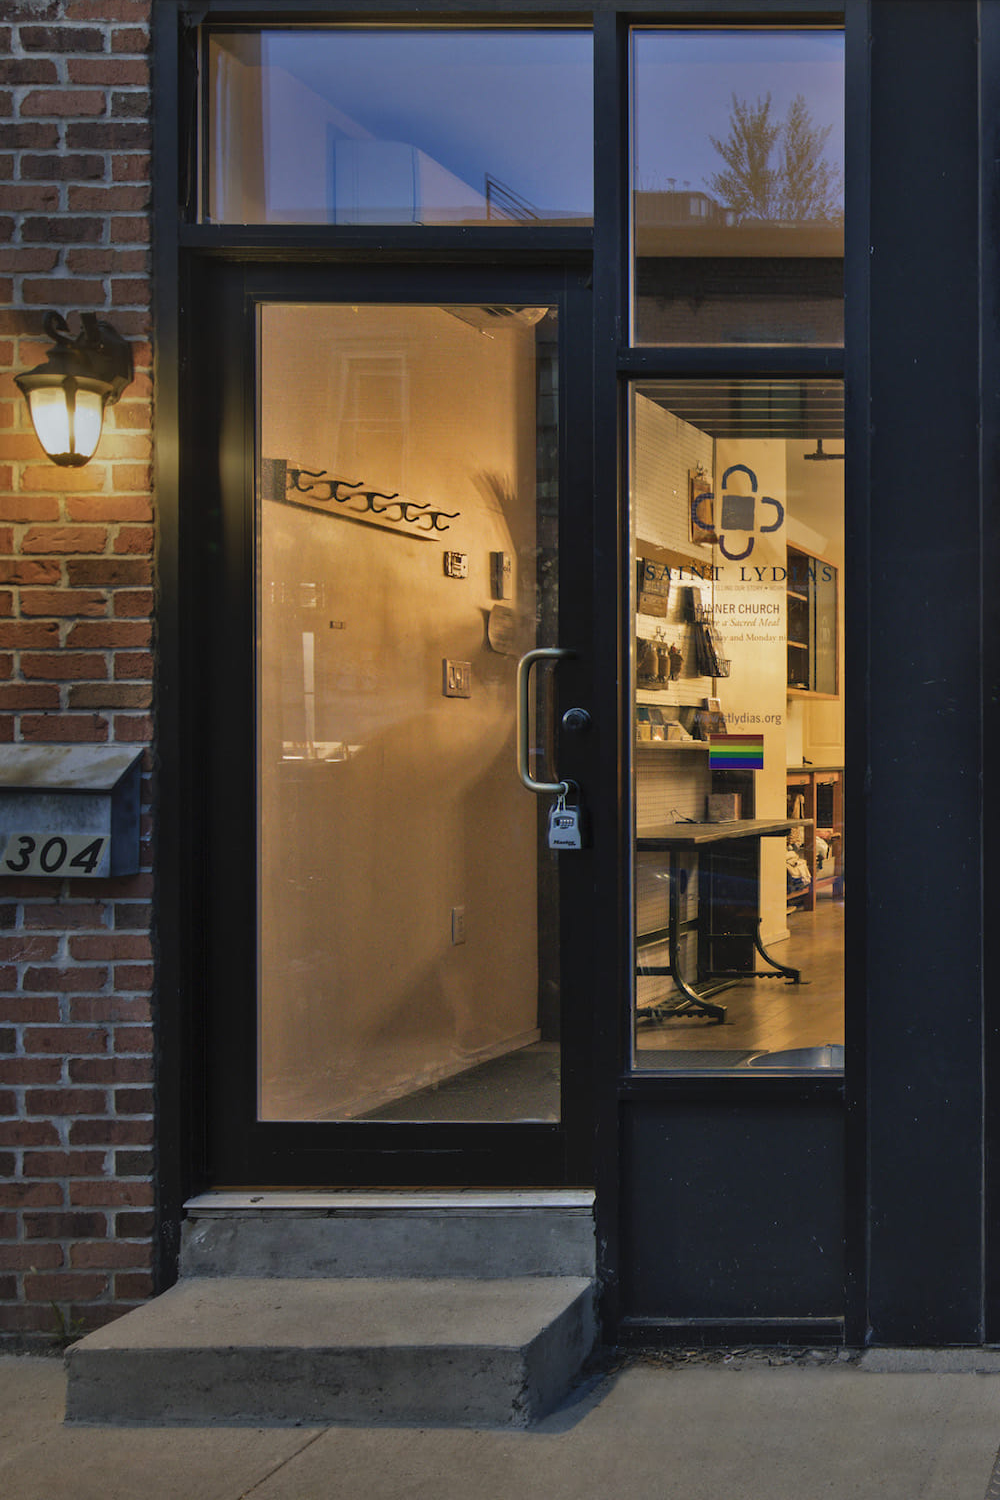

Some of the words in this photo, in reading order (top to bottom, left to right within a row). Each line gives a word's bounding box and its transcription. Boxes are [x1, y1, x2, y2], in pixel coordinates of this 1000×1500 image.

[645, 565, 725, 581] SAINT
[739, 566, 832, 582] LYDIAS
[696, 603, 735, 614] DINNER
[738, 603, 780, 614] CHURCH
[730, 617, 757, 627] Sacred
[759, 617, 780, 627] Meal
[730, 632, 744, 642] and
[746, 632, 777, 645] Monday
[693, 712, 782, 725] www.stlydias.org
[6, 835, 105, 874] 304
